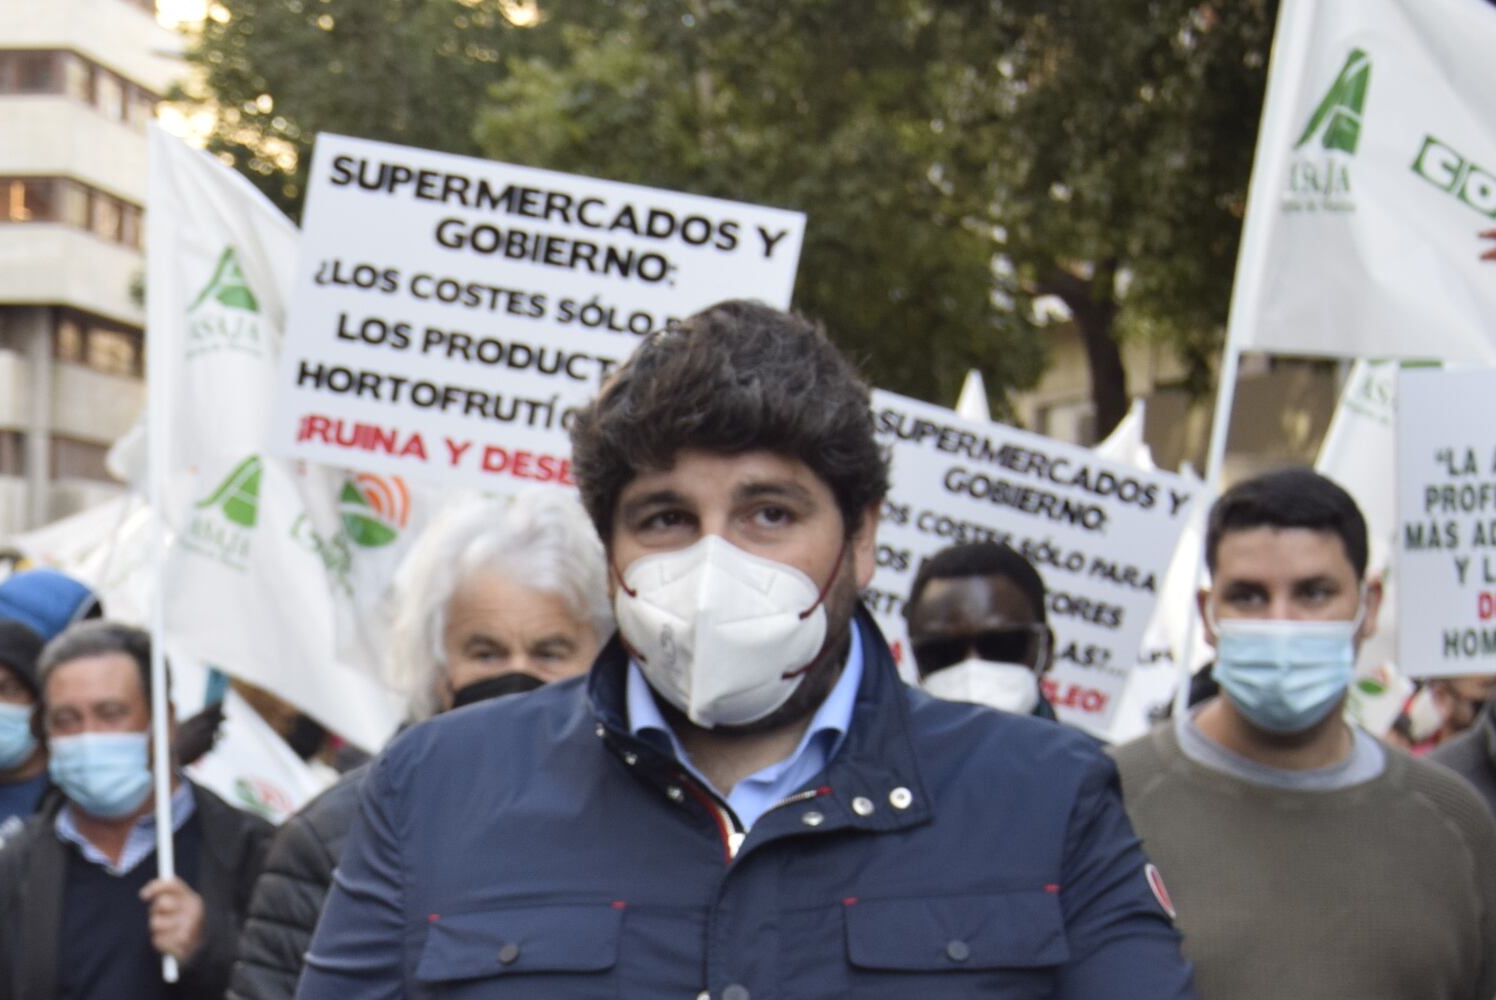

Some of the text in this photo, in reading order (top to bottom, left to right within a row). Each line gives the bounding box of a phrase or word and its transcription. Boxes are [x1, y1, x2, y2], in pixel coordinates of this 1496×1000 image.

[329, 154, 789, 258] SUPERMERCADOS Y
[314, 259, 400, 293] ¿LOS
[409, 273, 548, 319] COSTES
[556, 293, 654, 336] SÓLO
[336, 312, 617, 381] LOS PRODUCT
[443, 437, 473, 467] Y
[875, 408, 1190, 517] SUPERMERCADOS Y
[1424, 483, 1496, 514] PROF
[1089, 556, 1157, 595] PARA
[1453, 554, 1471, 587] Y
[1442, 627, 1496, 658] HOM
